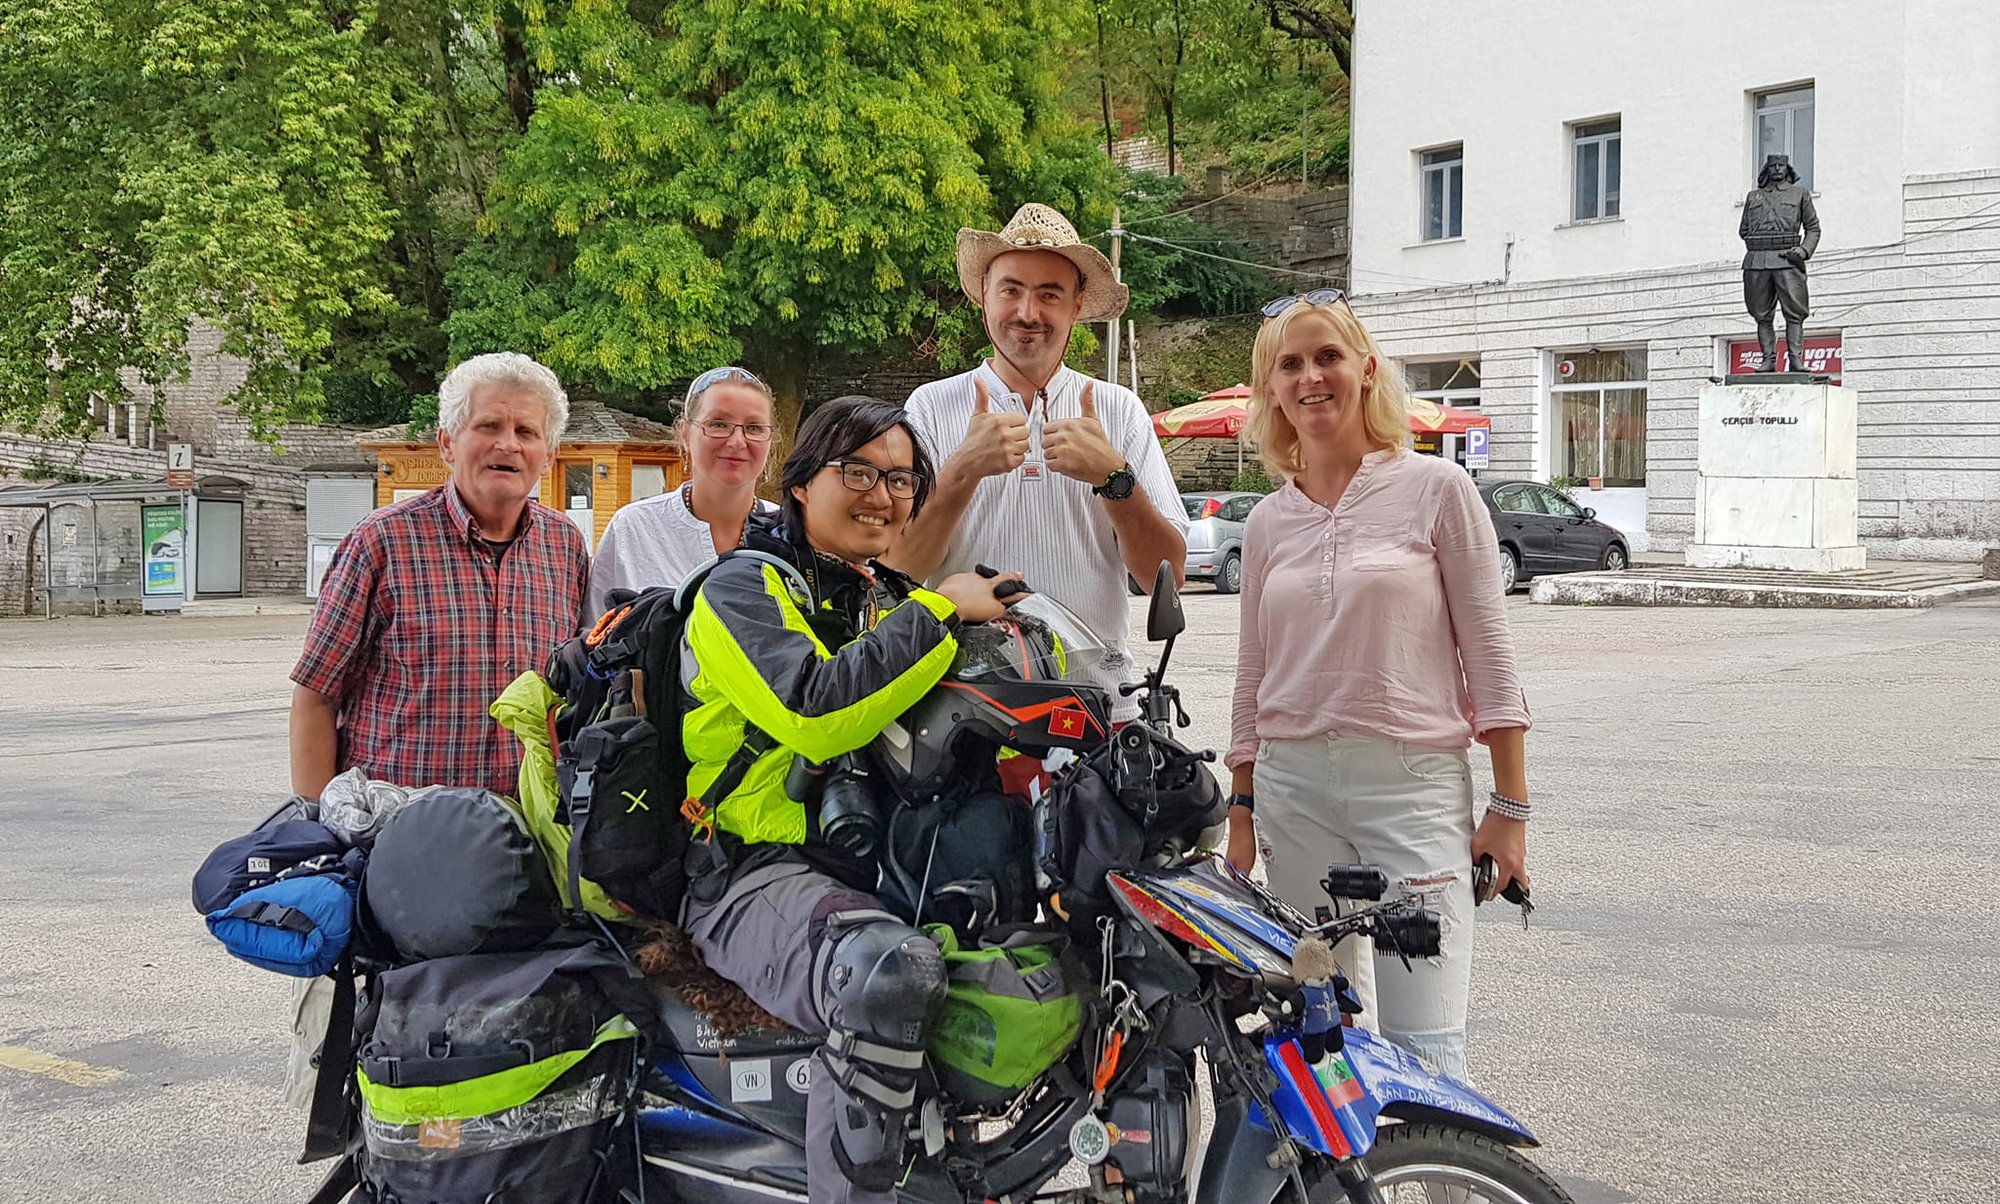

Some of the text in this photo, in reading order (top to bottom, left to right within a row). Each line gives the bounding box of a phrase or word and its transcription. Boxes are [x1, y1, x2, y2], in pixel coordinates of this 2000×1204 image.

[1470, 430, 1486, 454] P
[1267, 928, 1291, 947] VIE
[744, 1074, 758, 1088] VN
[796, 1064, 811, 1086] 6
